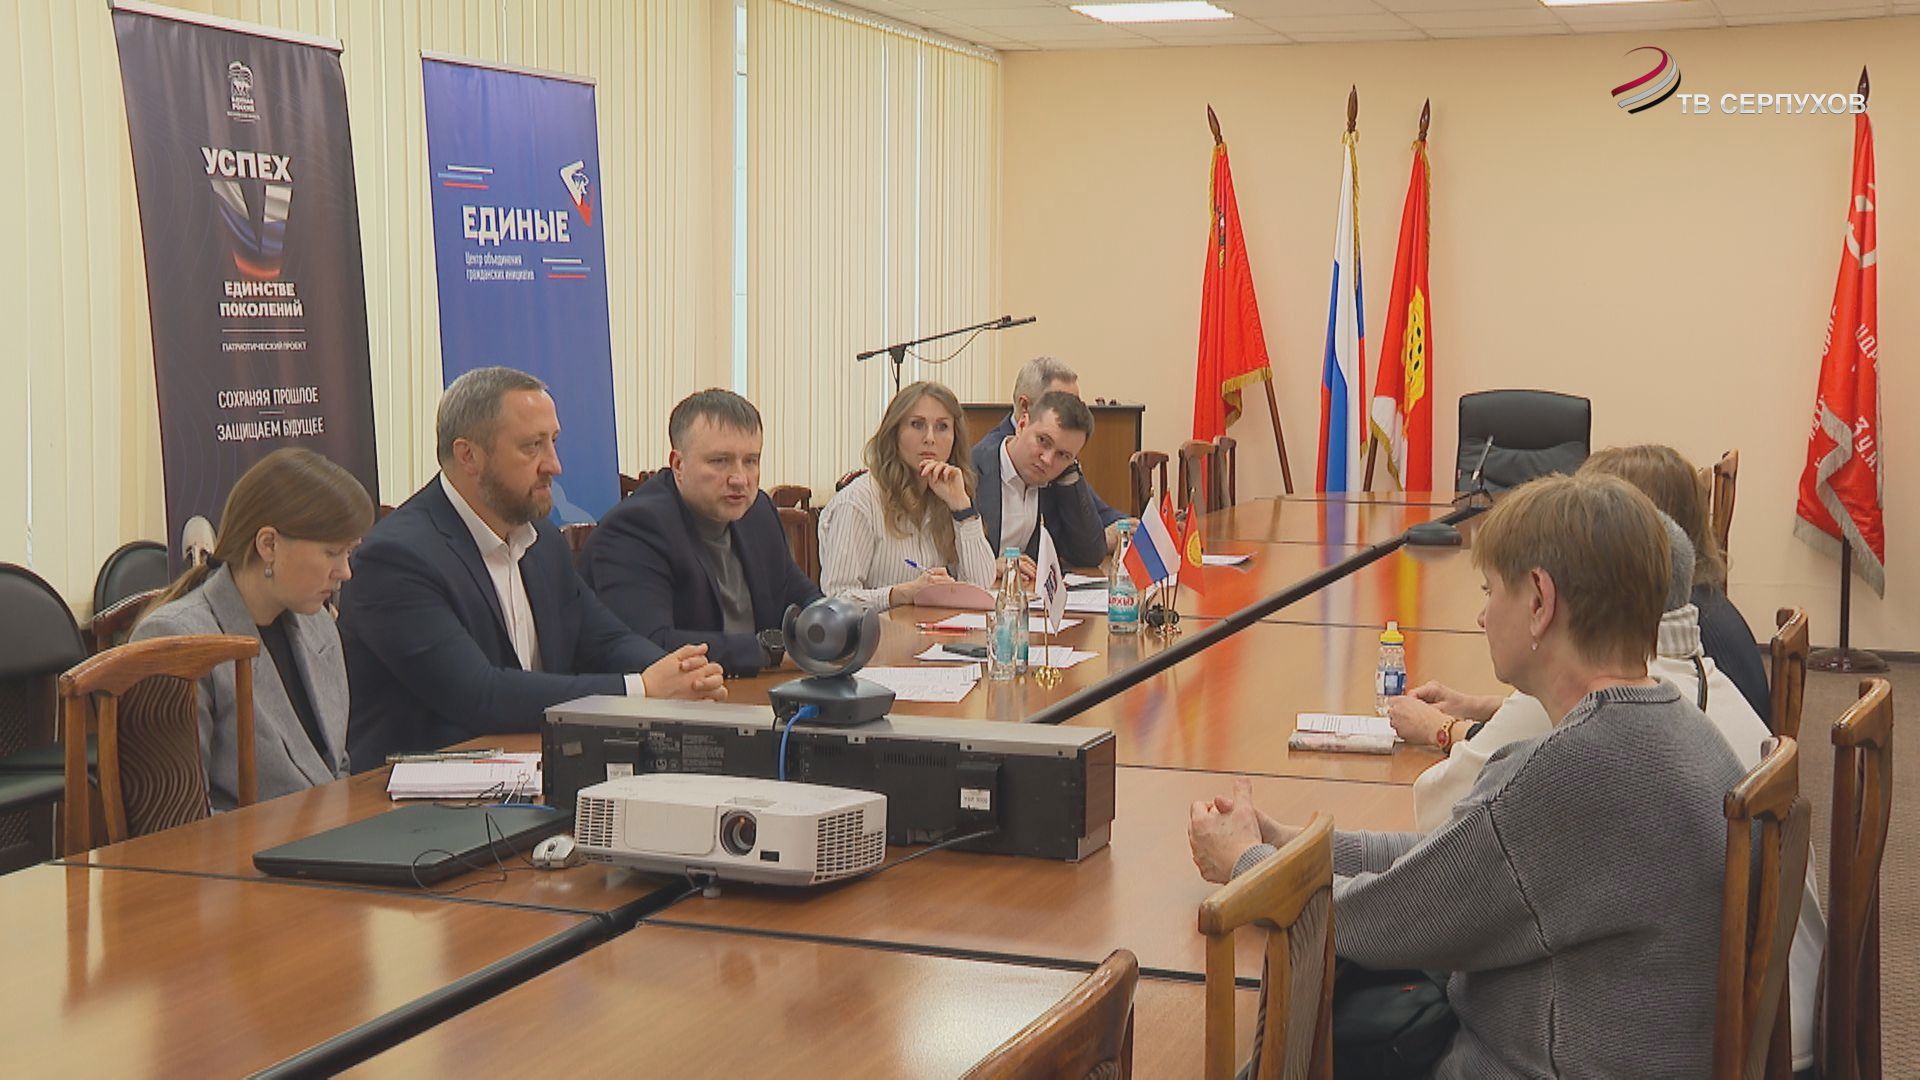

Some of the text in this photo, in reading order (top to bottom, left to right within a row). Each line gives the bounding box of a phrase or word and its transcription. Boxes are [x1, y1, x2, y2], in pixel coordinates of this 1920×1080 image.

[201, 147, 292, 182] УСПЕХ
[462, 204, 571, 246] ЕДИНЫЕ
[224, 280, 296, 298] ЕДИНСТВЕ
[219, 299, 304, 317] ПОКОЛЕНИЙ
[218, 386, 319, 408] СОХРАНЯЯ ПРОШЛОЕ
[217, 416, 325, 442] ЗАЩИЩАЕМ БУДУЩЕЕ
